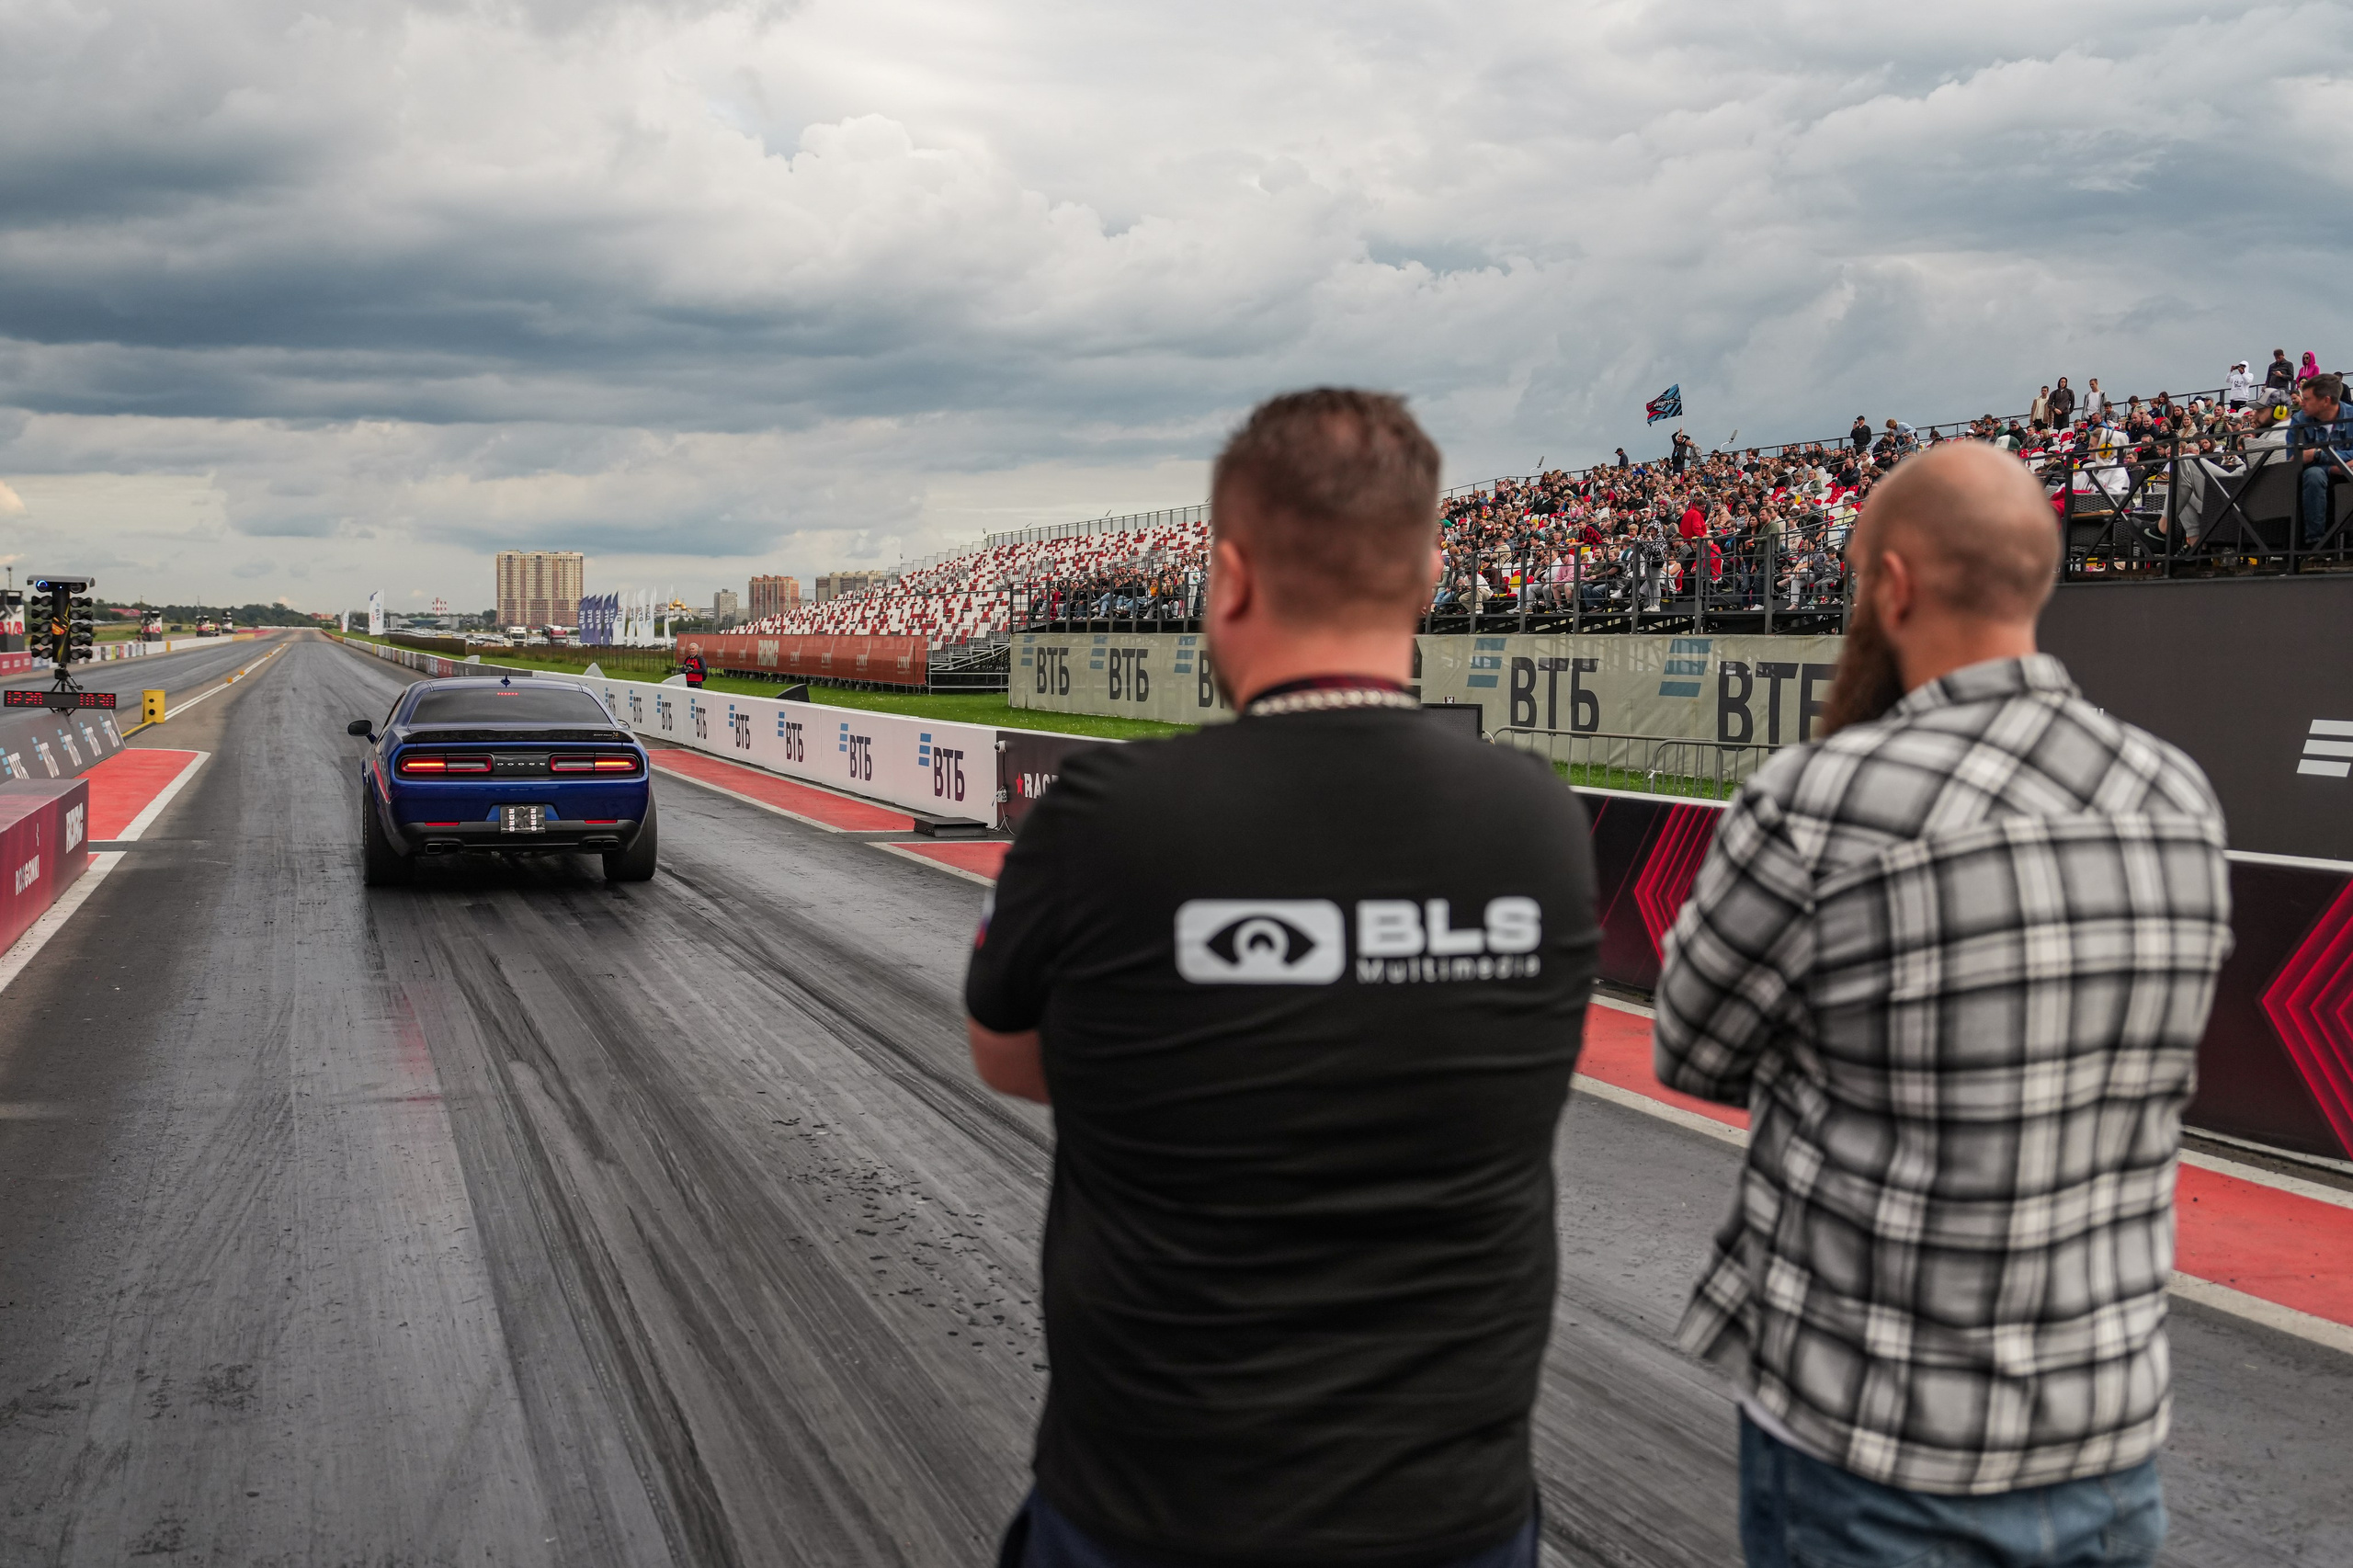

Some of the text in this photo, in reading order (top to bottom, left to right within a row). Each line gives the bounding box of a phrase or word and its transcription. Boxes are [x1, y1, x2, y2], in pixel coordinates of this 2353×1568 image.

[1037, 646, 1070, 696] ВТБ
[1109, 648, 1149, 702] ВТБ
[633, 696, 642, 724] ВТБ
[662, 701, 673, 732] ВТБ
[1510, 656, 1599, 739] ВТБ
[696, 706, 707, 740] ВТБ
[735, 713, 750, 750] ВТБ
[786, 722, 803, 763] ВТБ
[850, 734, 872, 781] ВТБ
[933, 746, 965, 802] ВТБ
[1023, 772, 1059, 800] RAC
[1356, 897, 1541, 957] BLS
[1356, 954, 1542, 984] Multimedia
